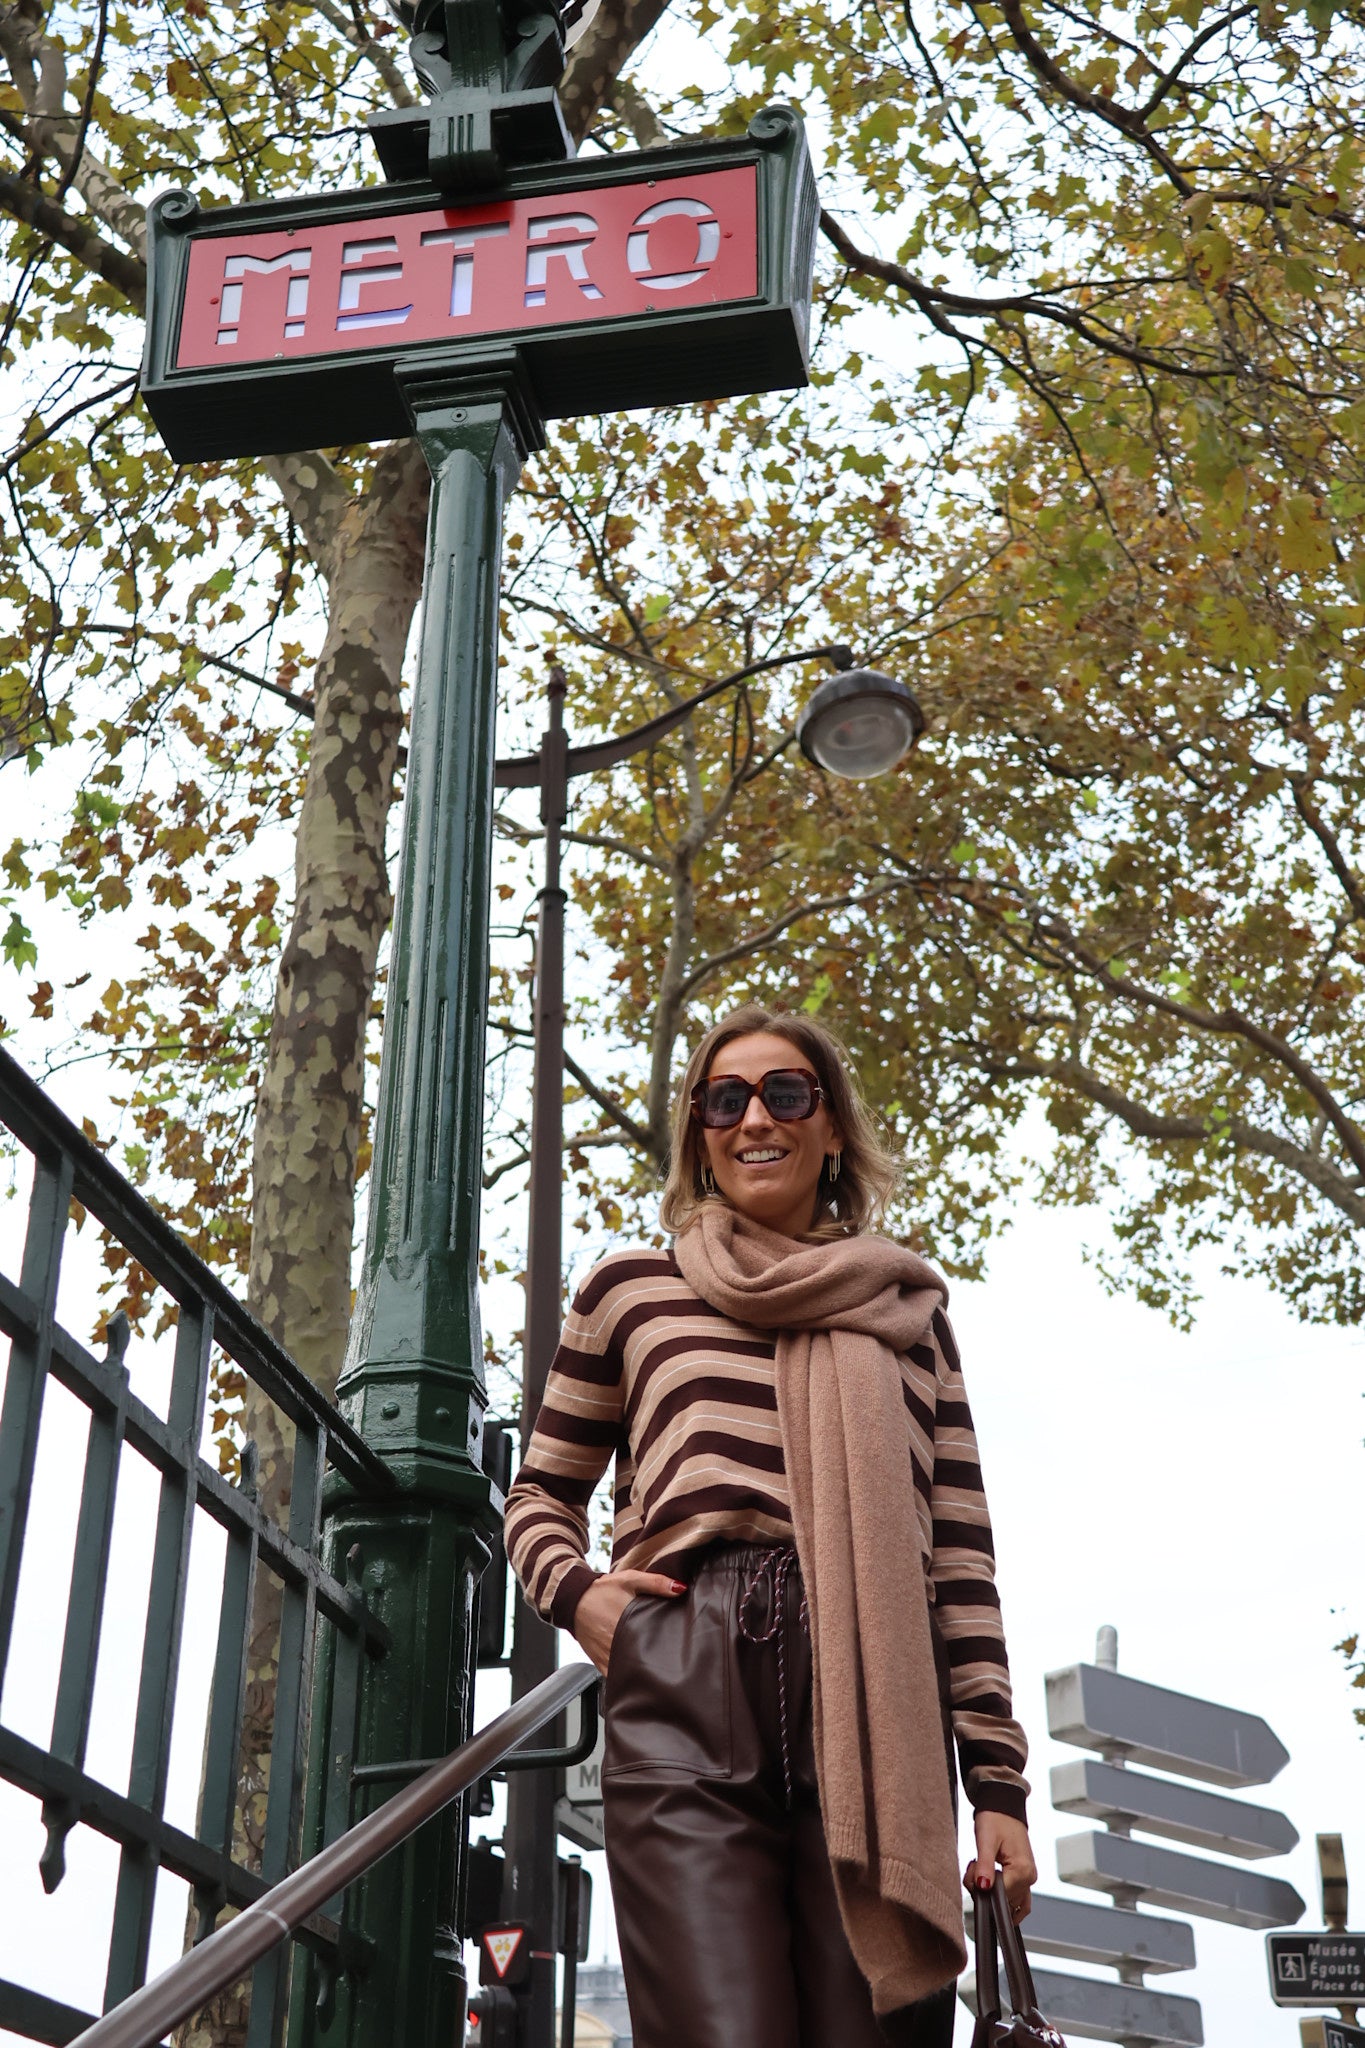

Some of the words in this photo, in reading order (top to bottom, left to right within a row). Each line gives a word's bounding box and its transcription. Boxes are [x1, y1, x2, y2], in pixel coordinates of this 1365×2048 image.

[215, 197, 720, 345] METRO
[1308, 1943, 1356, 1957] Musée
[1310, 1959, 1360, 1978] Égouts
[1311, 1979, 1345, 1991] Place
